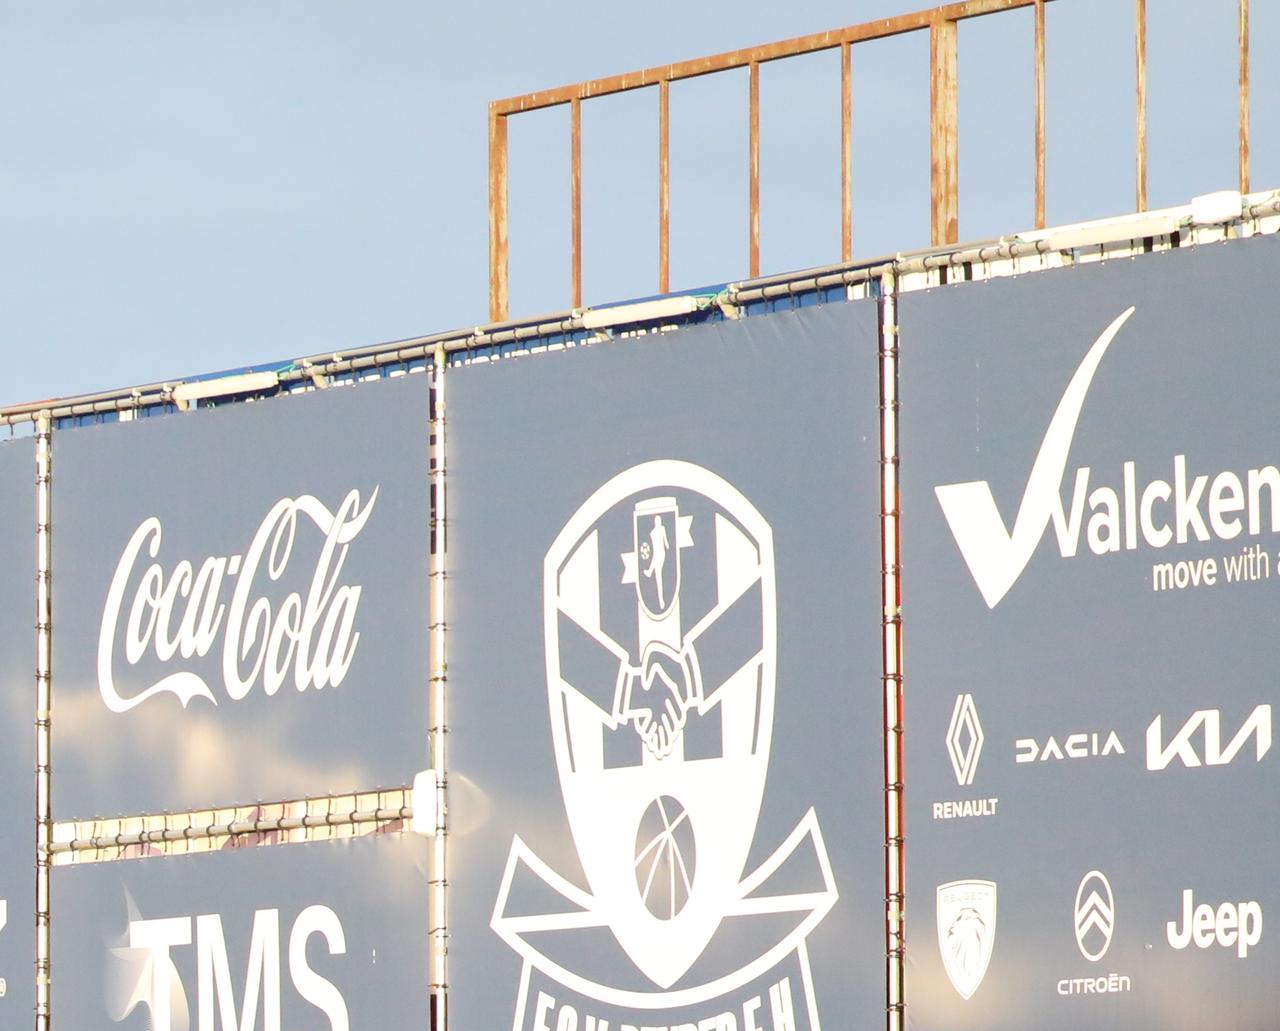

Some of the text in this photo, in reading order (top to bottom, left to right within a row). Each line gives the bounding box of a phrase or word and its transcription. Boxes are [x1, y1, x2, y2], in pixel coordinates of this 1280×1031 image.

[1153, 543, 1270, 591] move with
[98, 483, 379, 712] Coca-Cola
[1016, 730, 1125, 763] DACIA
[933, 798, 998, 819] RENAULT
[1166, 889, 1263, 958] Jeep
